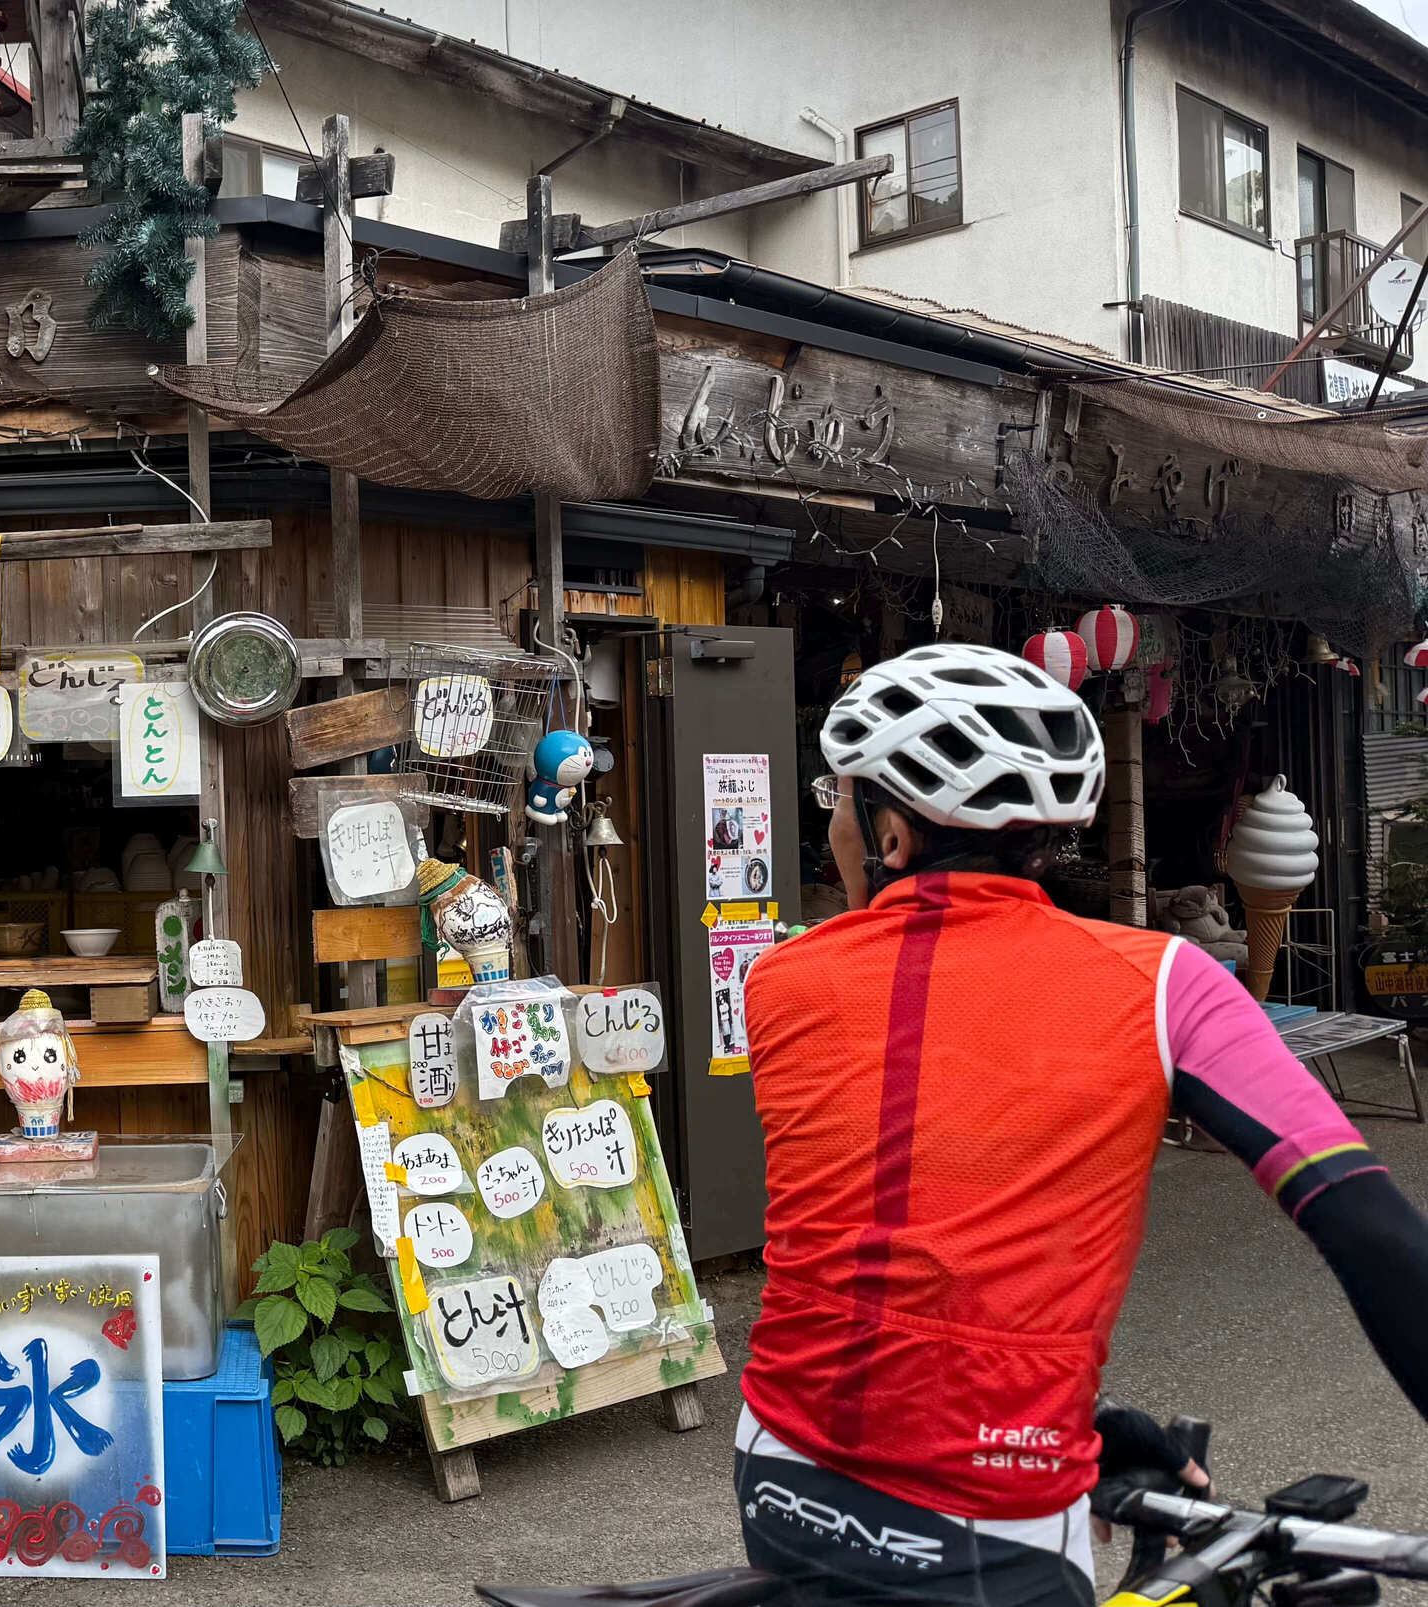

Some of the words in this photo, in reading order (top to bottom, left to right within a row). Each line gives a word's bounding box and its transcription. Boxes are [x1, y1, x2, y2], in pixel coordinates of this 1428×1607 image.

[142, 696, 168, 785] とんとん
[718, 779, 756, 794] 旅籠ふじ
[584, 998, 660, 1037] とんじる
[412, 1060, 429, 1070] 200
[413, 1023, 448, 1097] 甘酒
[605, 1044, 649, 1064] 500
[606, 1140, 626, 1175] 汁
[419, 1175, 447, 1186] 200
[569, 1162, 598, 1181] 500
[522, 1176, 539, 1198] 汁
[494, 1191, 520, 1209] 500
[431, 1247, 455, 1259] 500
[586, 1257, 654, 1297] どんじる
[438, 1282, 530, 1347] とん汁
[611, 1299, 640, 1322] 500
[472, 1347, 520, 1375] 500
[978, 1423, 1062, 1448] traffic
[972, 1451, 1067, 1474] safety
